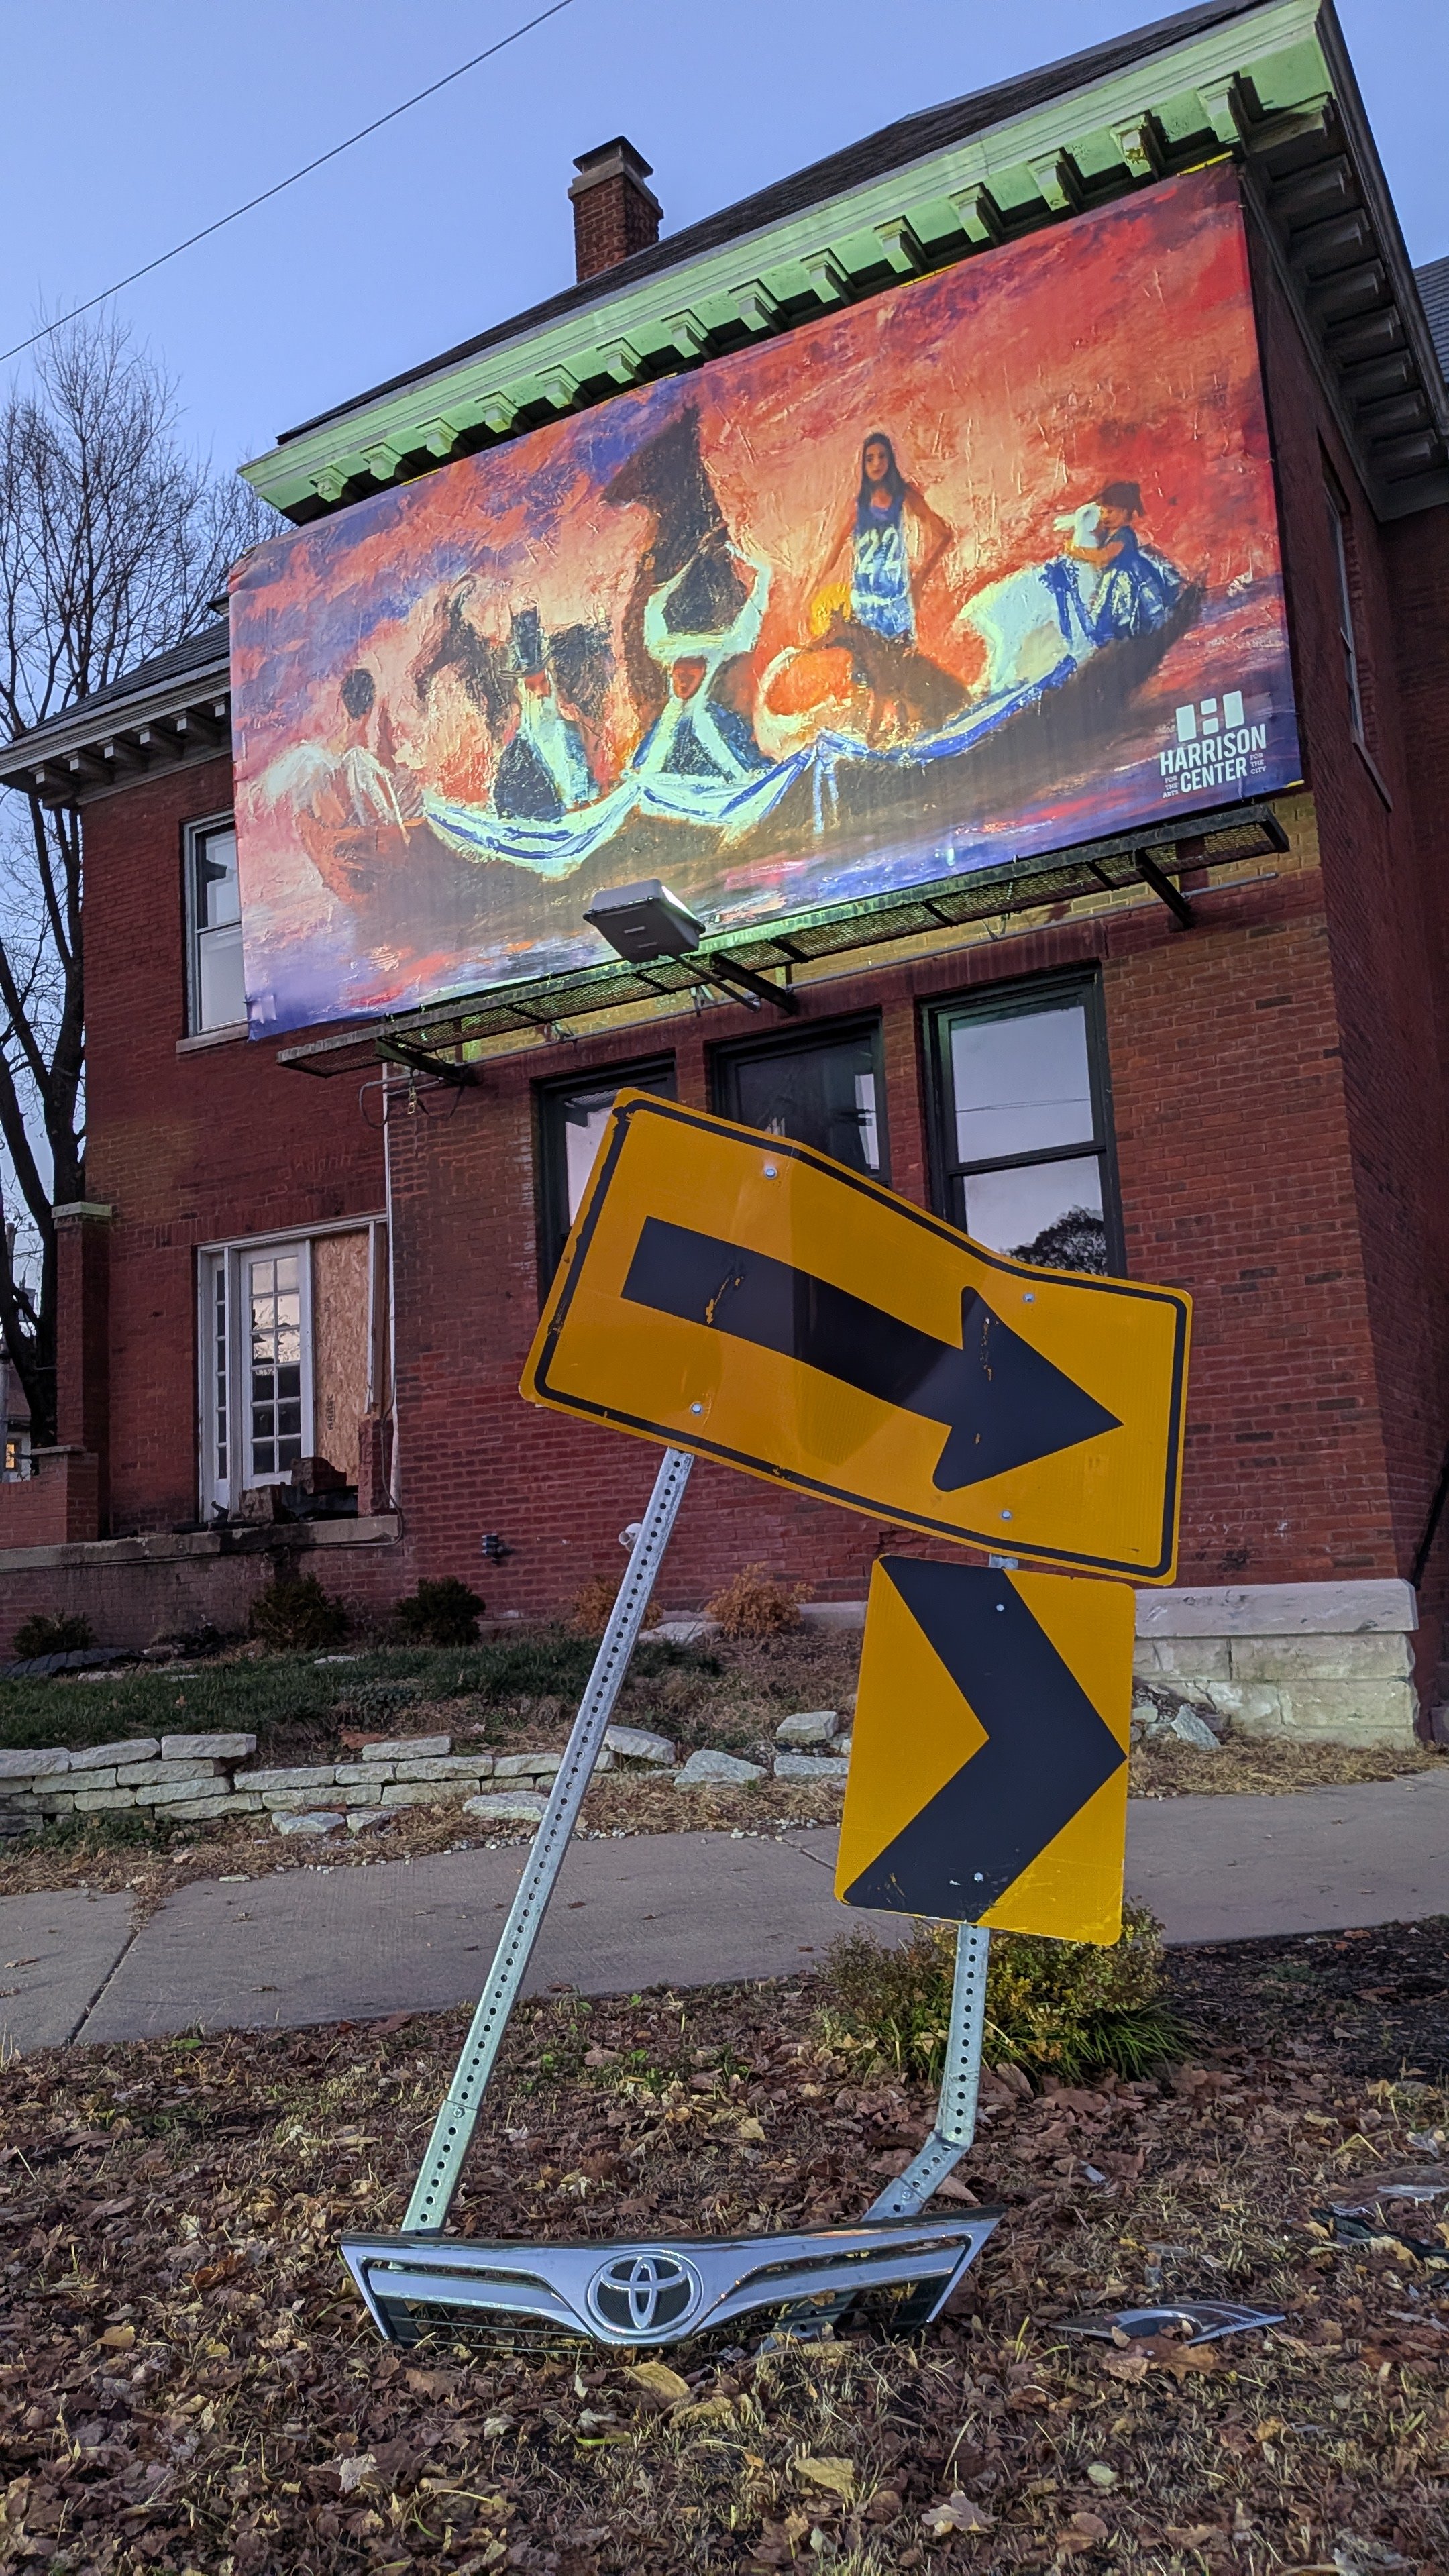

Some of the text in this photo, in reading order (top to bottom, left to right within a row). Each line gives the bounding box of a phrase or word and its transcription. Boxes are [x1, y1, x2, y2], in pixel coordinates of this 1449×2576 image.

[1159, 723, 1267, 777] HARRISON
[1250, 753, 1264, 761] FOR
[1250, 759, 1265, 767] THE
[1250, 765, 1267, 775] CITY
[1165, 775, 1178, 784] FOR
[1180, 757, 1248, 793] CENTER
[1164, 782, 1179, 791] THE
[1162, 789, 1179, 798] ARTS
